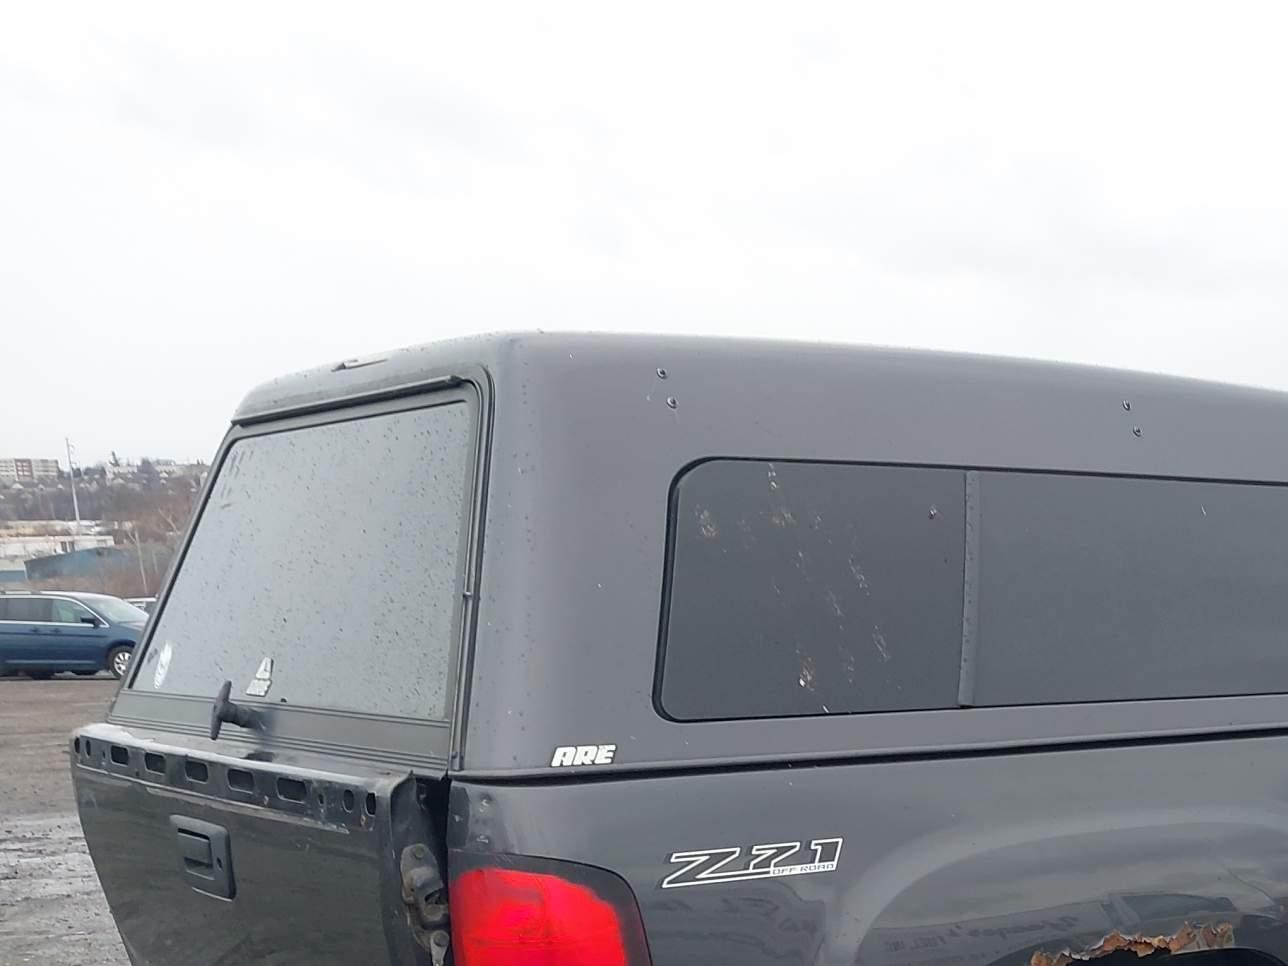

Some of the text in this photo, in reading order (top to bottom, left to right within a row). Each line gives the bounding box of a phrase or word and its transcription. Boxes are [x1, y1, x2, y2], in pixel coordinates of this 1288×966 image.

[551, 744, 616, 767] ARE
[661, 838, 843, 888] Z71
[800, 863, 835, 873] ROAD
